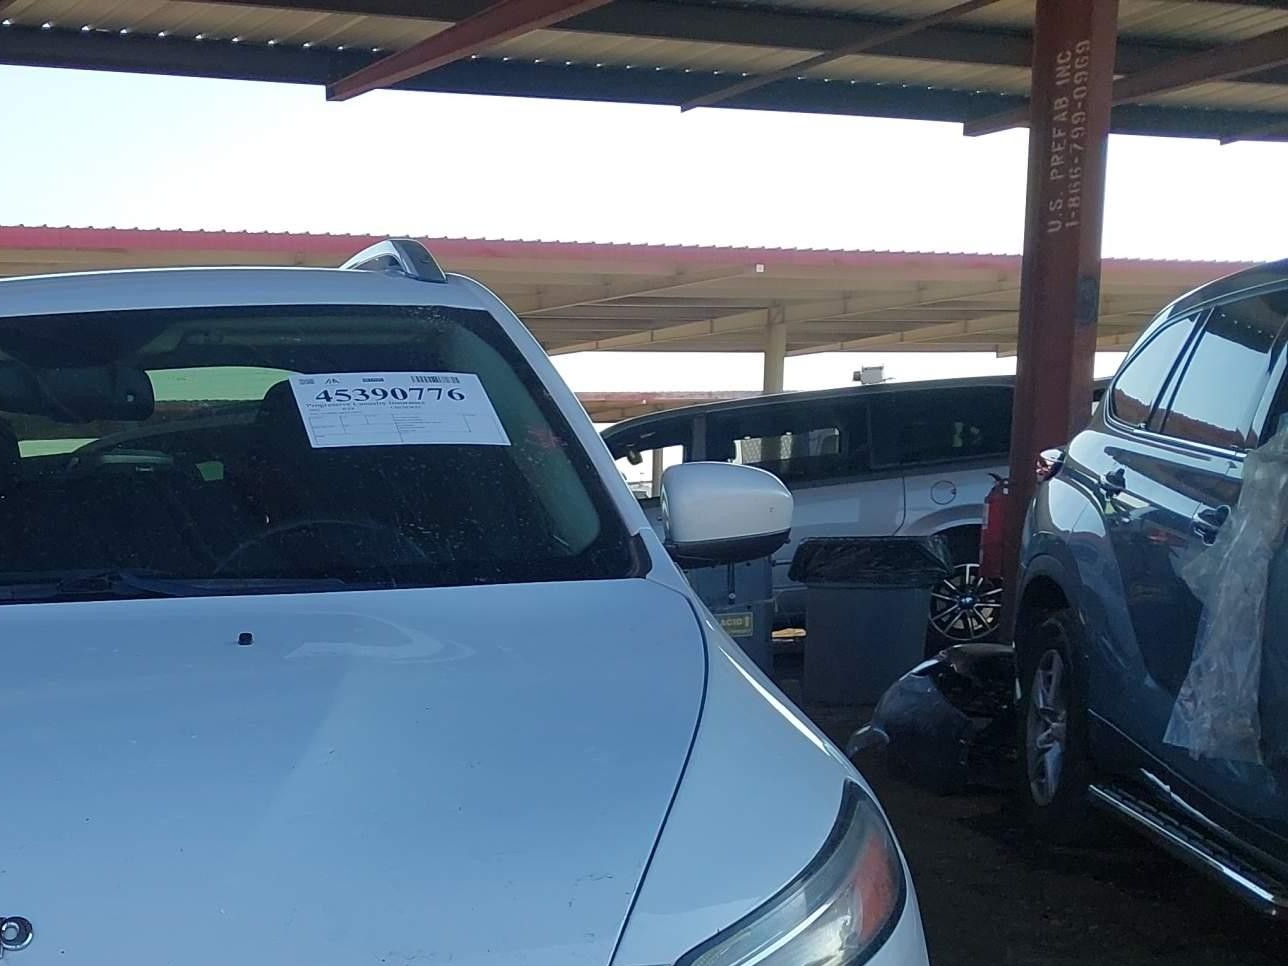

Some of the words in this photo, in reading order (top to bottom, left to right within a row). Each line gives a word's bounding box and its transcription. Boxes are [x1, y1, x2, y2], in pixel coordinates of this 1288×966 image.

[1050, 96, 1070, 181] PREFAB
[1047, 191, 1064, 233] U.S.
[315, 386, 465, 402] 45390776
